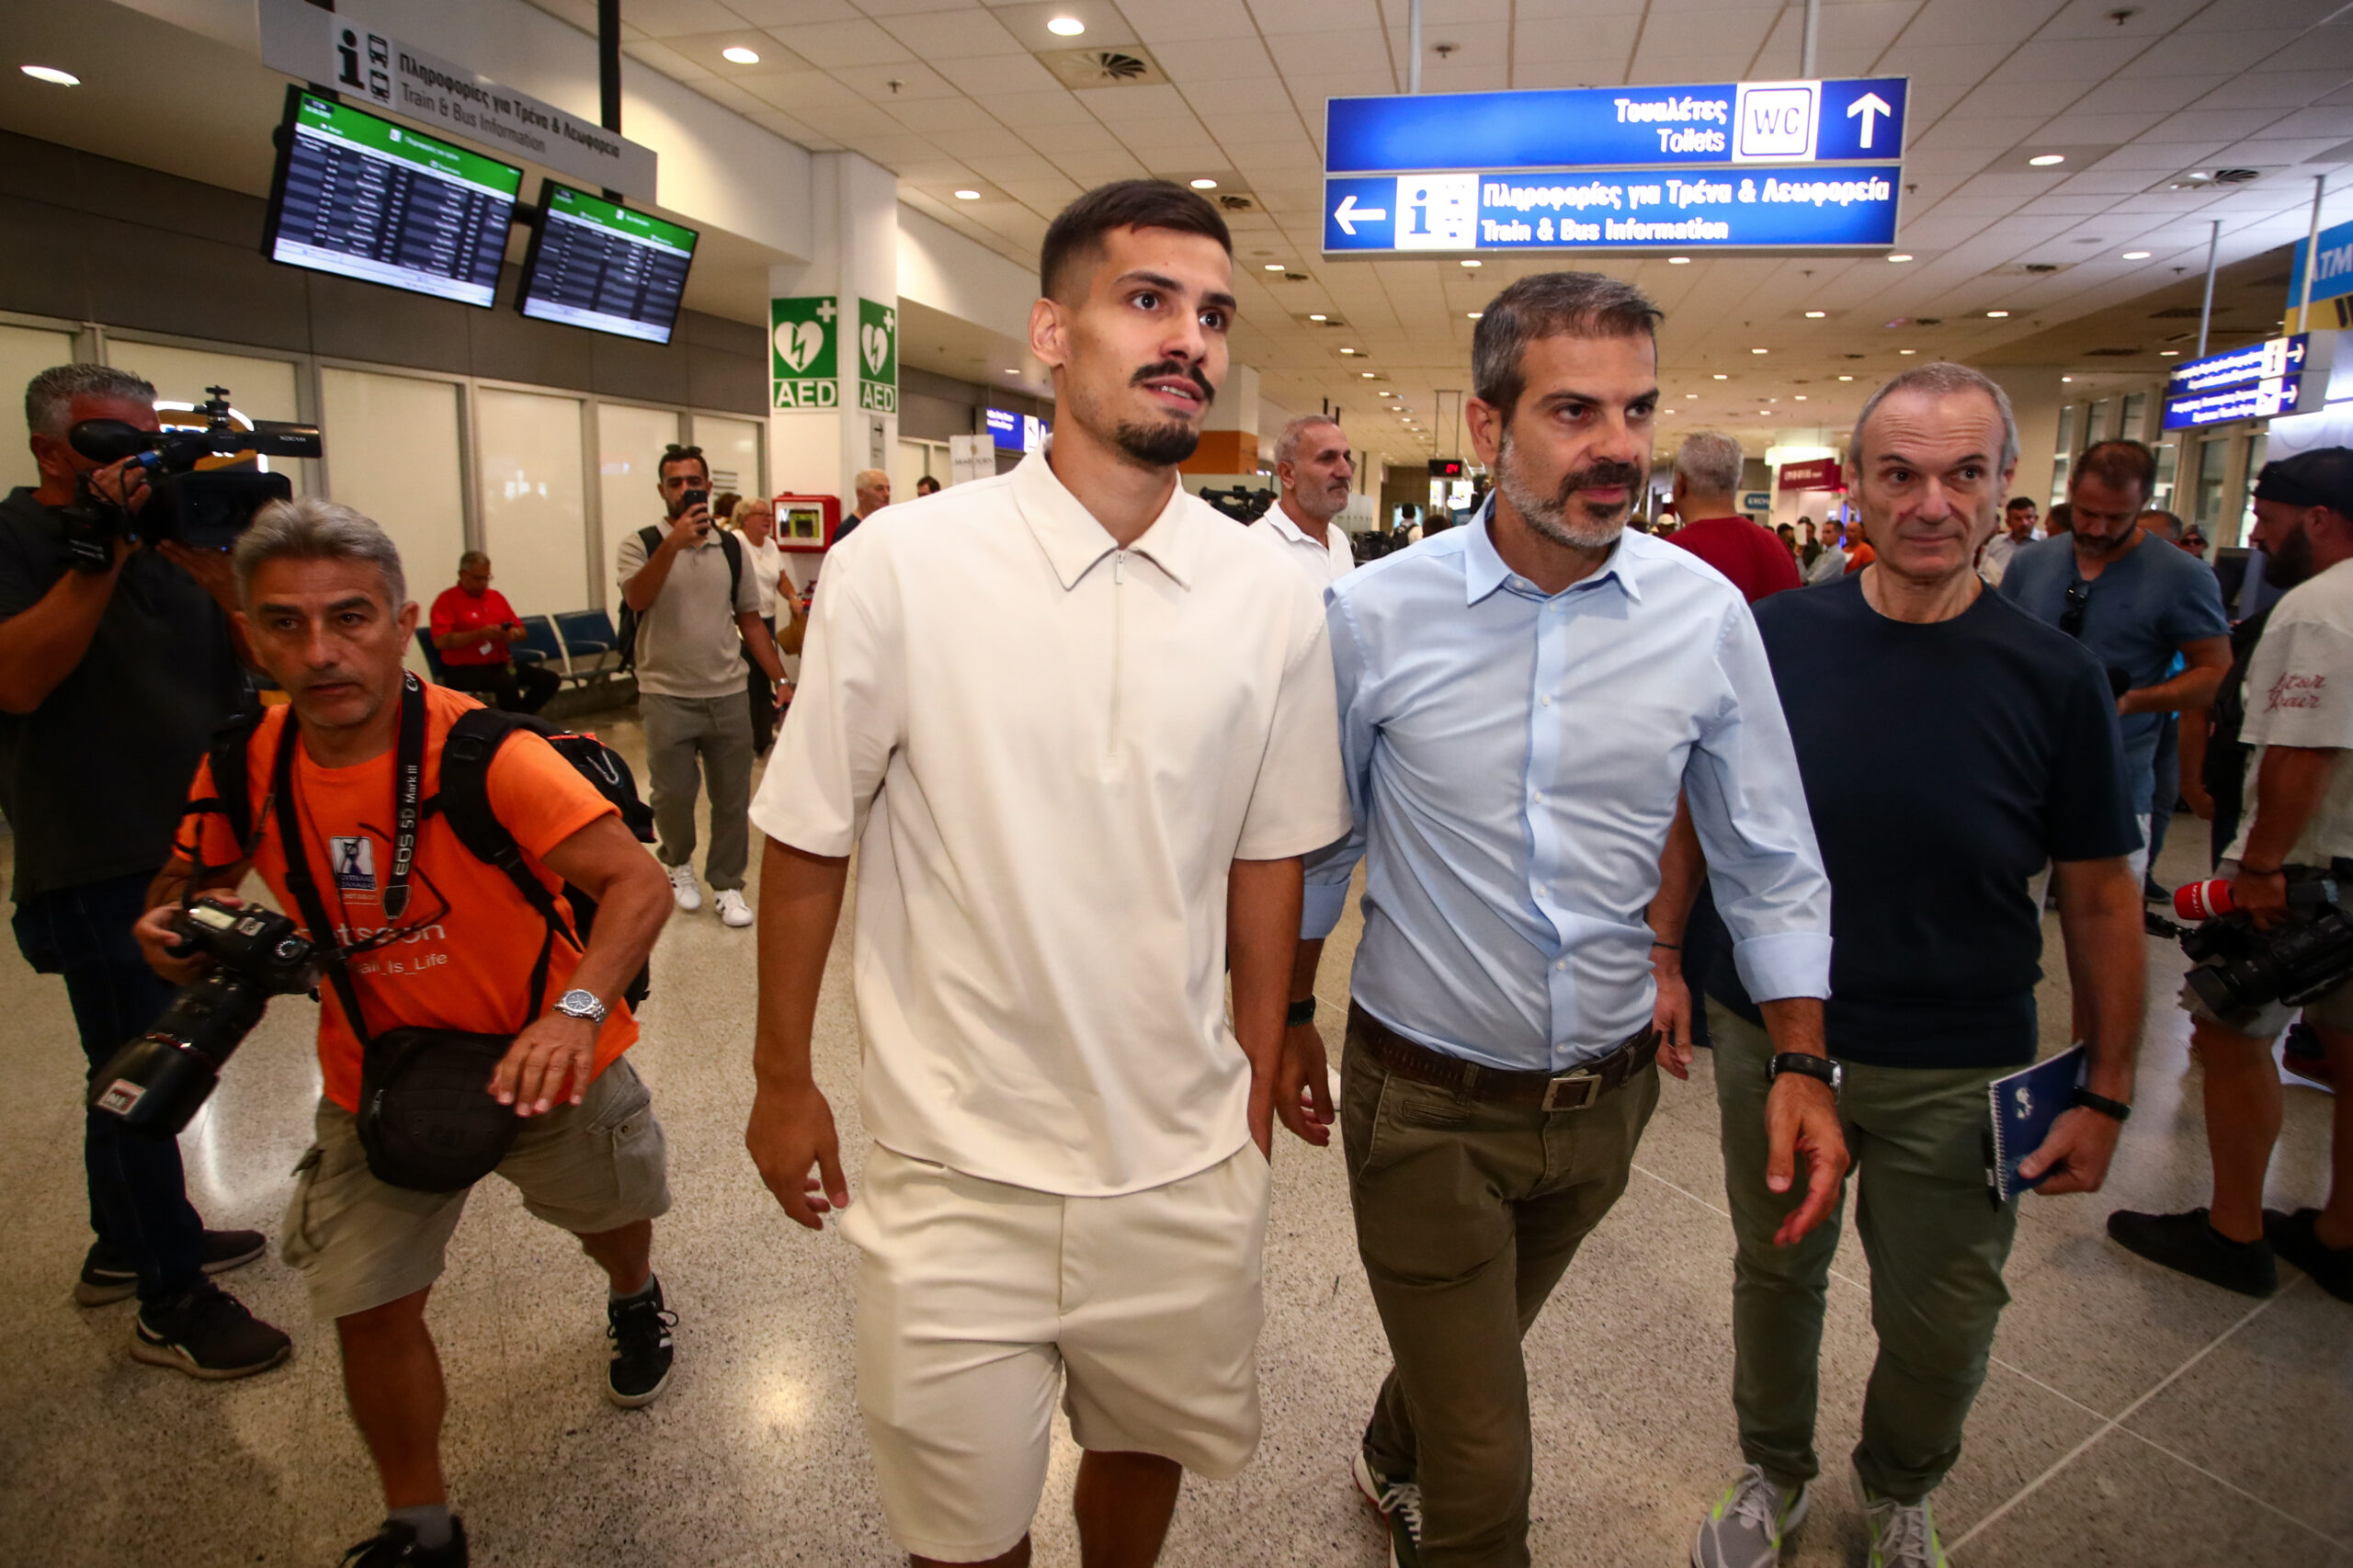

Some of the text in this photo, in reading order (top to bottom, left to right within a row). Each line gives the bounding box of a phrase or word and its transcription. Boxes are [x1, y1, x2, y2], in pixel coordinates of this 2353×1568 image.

[401, 82, 437, 111] Train
[438, 97, 449, 118] &
[453, 102, 477, 127] Bus
[480, 113, 546, 153] Information
[1614, 96, 1729, 125] Τουαλέτες
[1754, 107, 1800, 135] WC
[1656, 127, 1725, 153] Toilets
[1483, 176, 1890, 211] Πληροφορίες για Τρένα & Λεωφορεία
[1481, 217, 1729, 242] Train & Bus Information
[776, 381, 836, 407] AED
[862, 382, 894, 412] AED
[406, 777, 417, 802] Mark
[402, 808, 415, 828] 5D
[395, 835, 414, 875] EOS
